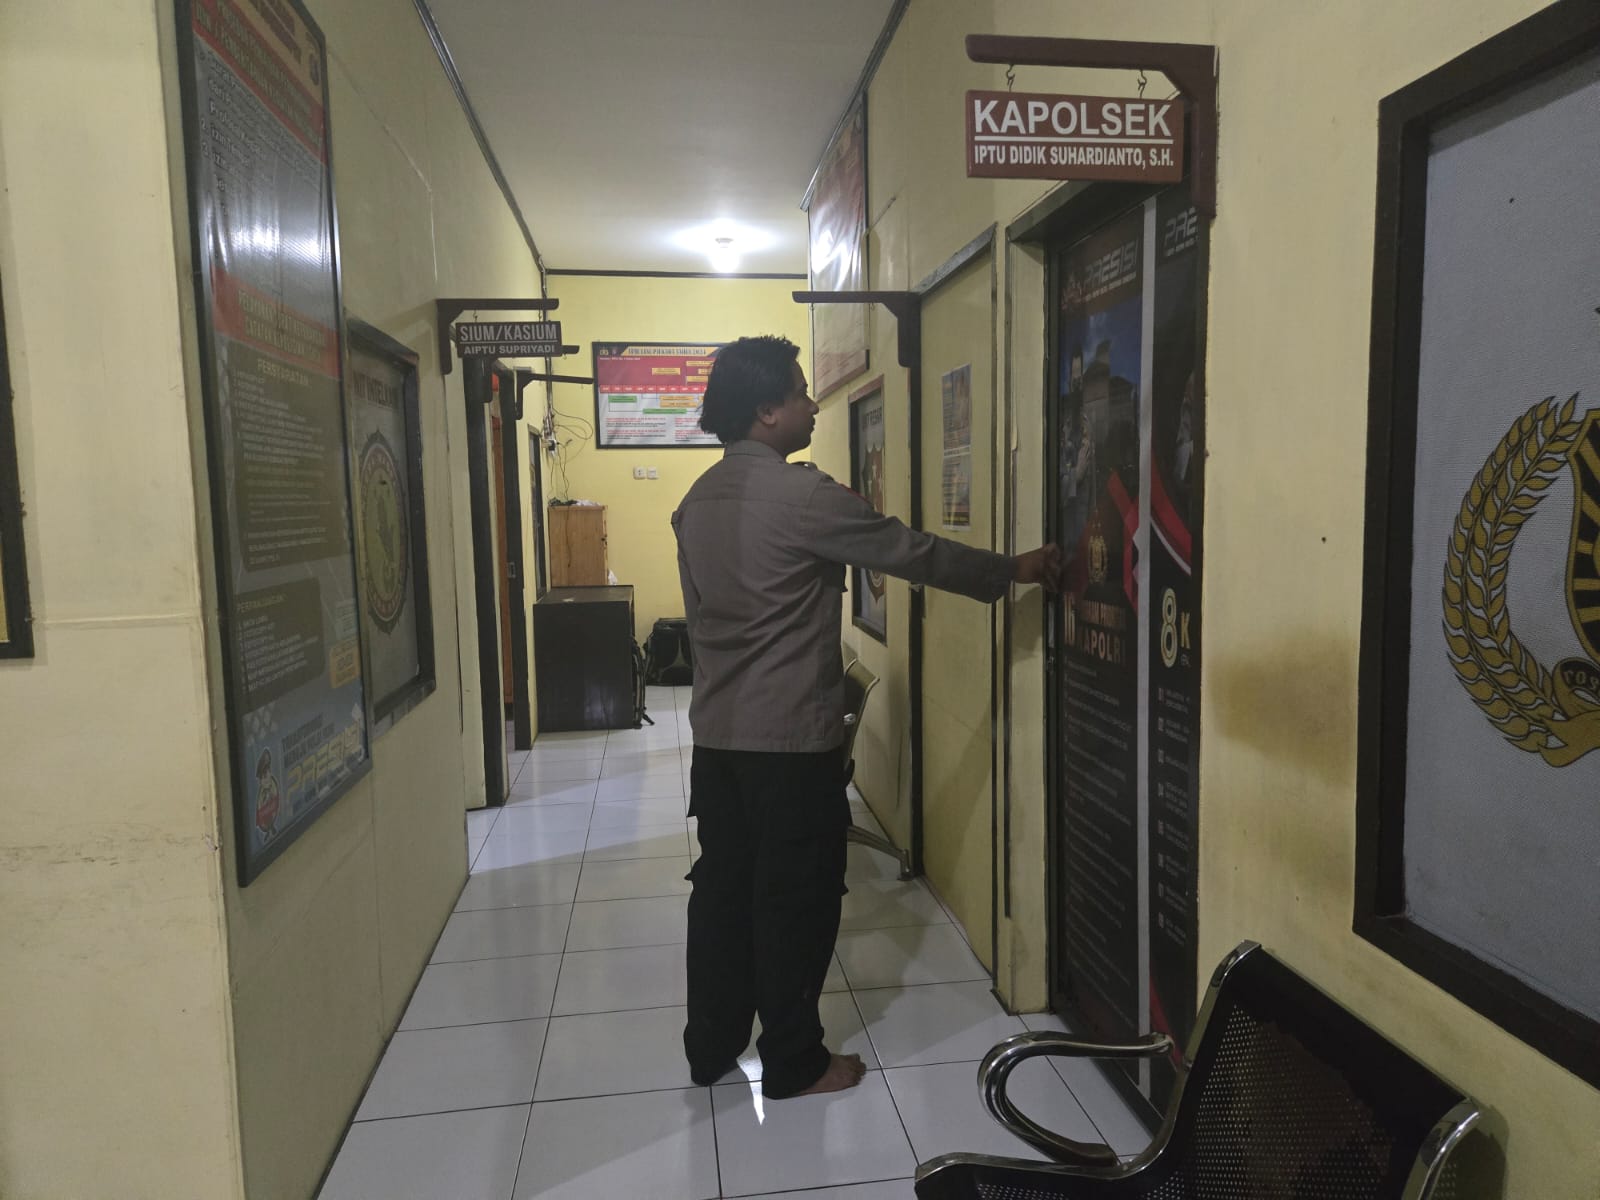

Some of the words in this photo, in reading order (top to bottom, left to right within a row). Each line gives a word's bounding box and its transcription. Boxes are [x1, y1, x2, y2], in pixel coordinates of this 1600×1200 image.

[974, 99, 1171, 137] KAPOLSEK
[974, 145, 1006, 164] IPTU
[1010, 146, 1047, 165] DIDIK
[1050, 146, 1146, 170] SUHARDIANTO,
[1149, 150, 1174, 166] S.H.
[1163, 206, 1199, 248] PRE
[460, 323, 557, 342] SIUM/KASIUM
[464, 345, 496, 355] AIPTU
[498, 344, 555, 354] SUPRIYADI
[1160, 587, 1178, 669] 8
